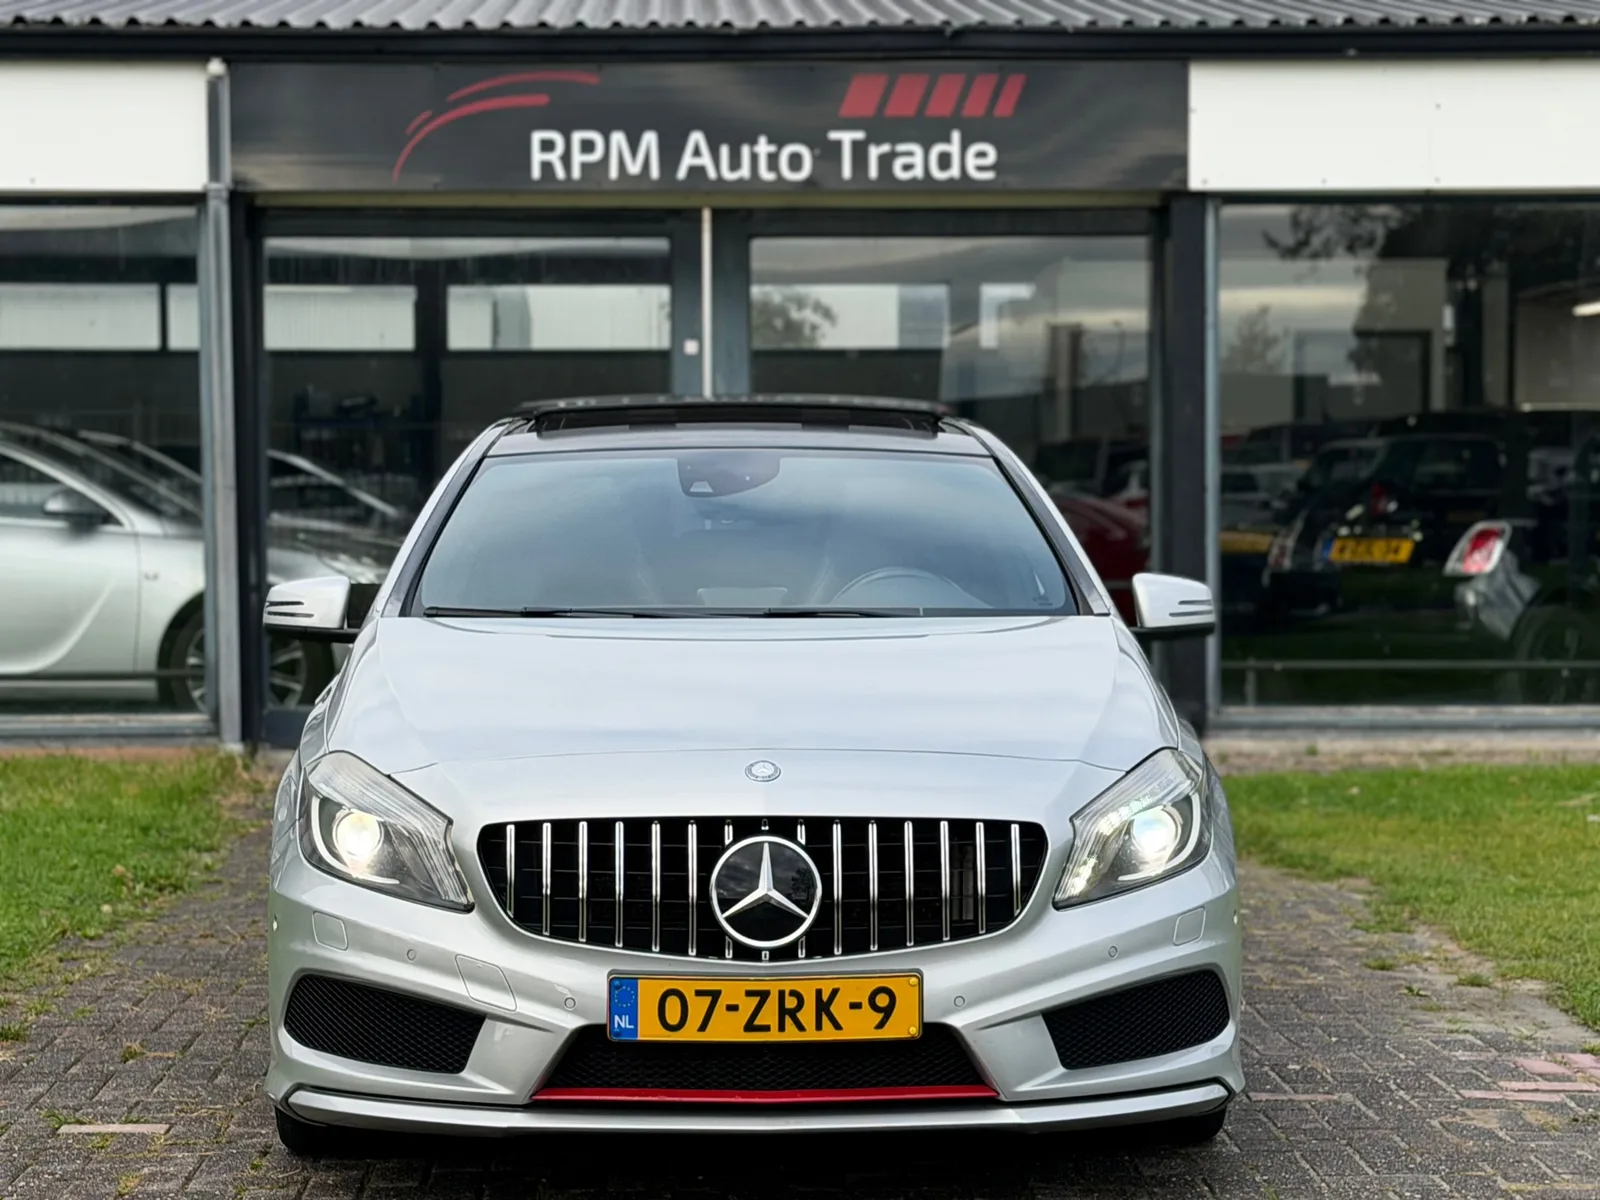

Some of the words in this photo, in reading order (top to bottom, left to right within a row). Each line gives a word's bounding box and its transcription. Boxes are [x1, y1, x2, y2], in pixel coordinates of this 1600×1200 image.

[530, 130, 660, 181] RPM
[676, 130, 813, 182] Auto
[827, 129, 998, 182] Trade
[614, 1014, 634, 1029] NL
[657, 986, 897, 1033] 07-ZRK-9
